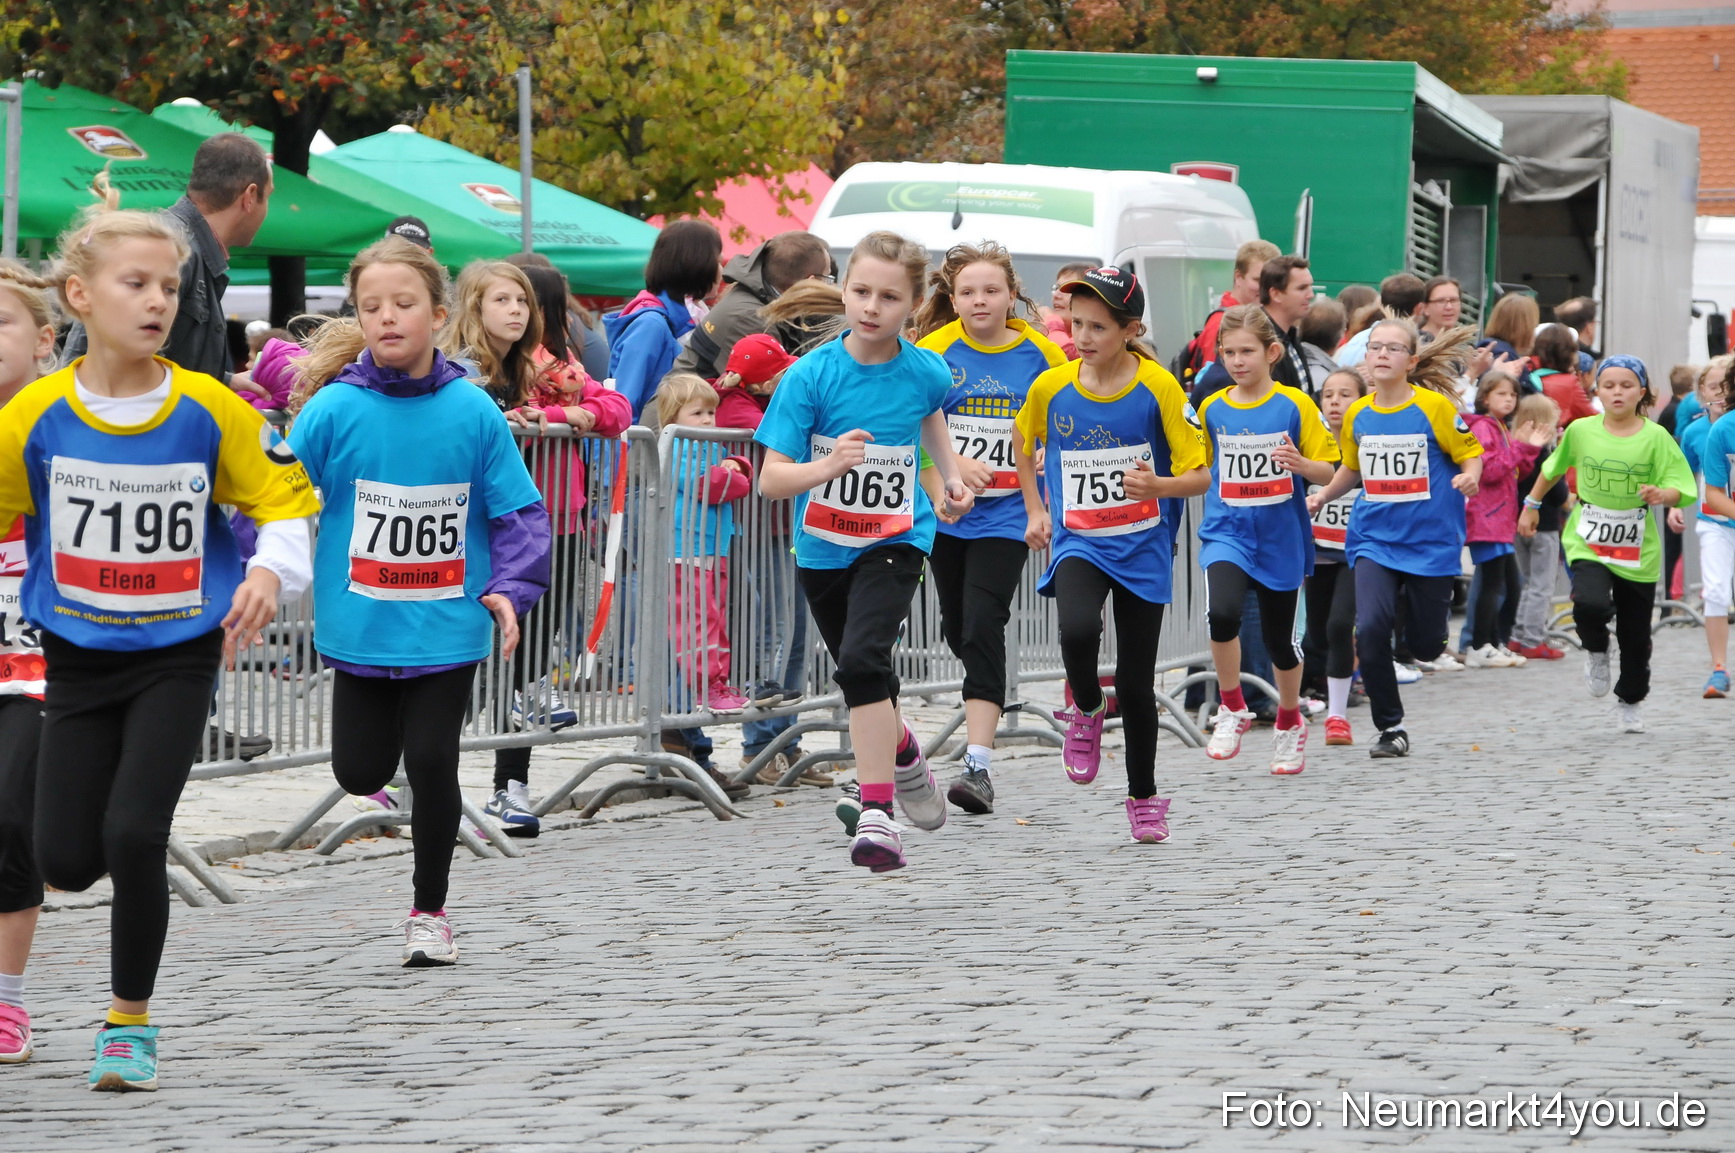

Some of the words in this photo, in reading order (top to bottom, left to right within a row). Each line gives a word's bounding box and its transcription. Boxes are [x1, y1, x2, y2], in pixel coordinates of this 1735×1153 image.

[957, 186, 1038, 198] Europcar
[949, 422, 976, 433] PARTL
[977, 425, 1013, 435] Neumark
[1219, 441, 1239, 450] PARTL
[1240, 441, 1277, 450] Neumarkt
[862, 456, 900, 466] umarkt
[1063, 459, 1091, 469] PARTL
[1366, 451, 1421, 476] 7167
[54, 471, 105, 492] PARTL
[109, 479, 183, 494] Neumarkt
[1070, 469, 1138, 505] 753
[1239, 485, 1270, 497] Maria
[358, 491, 396, 508] PARTL
[398, 496, 452, 510] Neumarkt
[67, 496, 193, 555] 7196
[830, 512, 882, 534] Tamina
[1095, 512, 1129, 524] Selina
[1604, 513, 1636, 521] Neumarkt
[366, 510, 459, 557] 7065
[1585, 520, 1638, 544] 7004
[99, 567, 156, 590] Elena
[378, 567, 439, 585] Samina
[54, 604, 203, 626] www.stadtlauf-neumarkt.de
